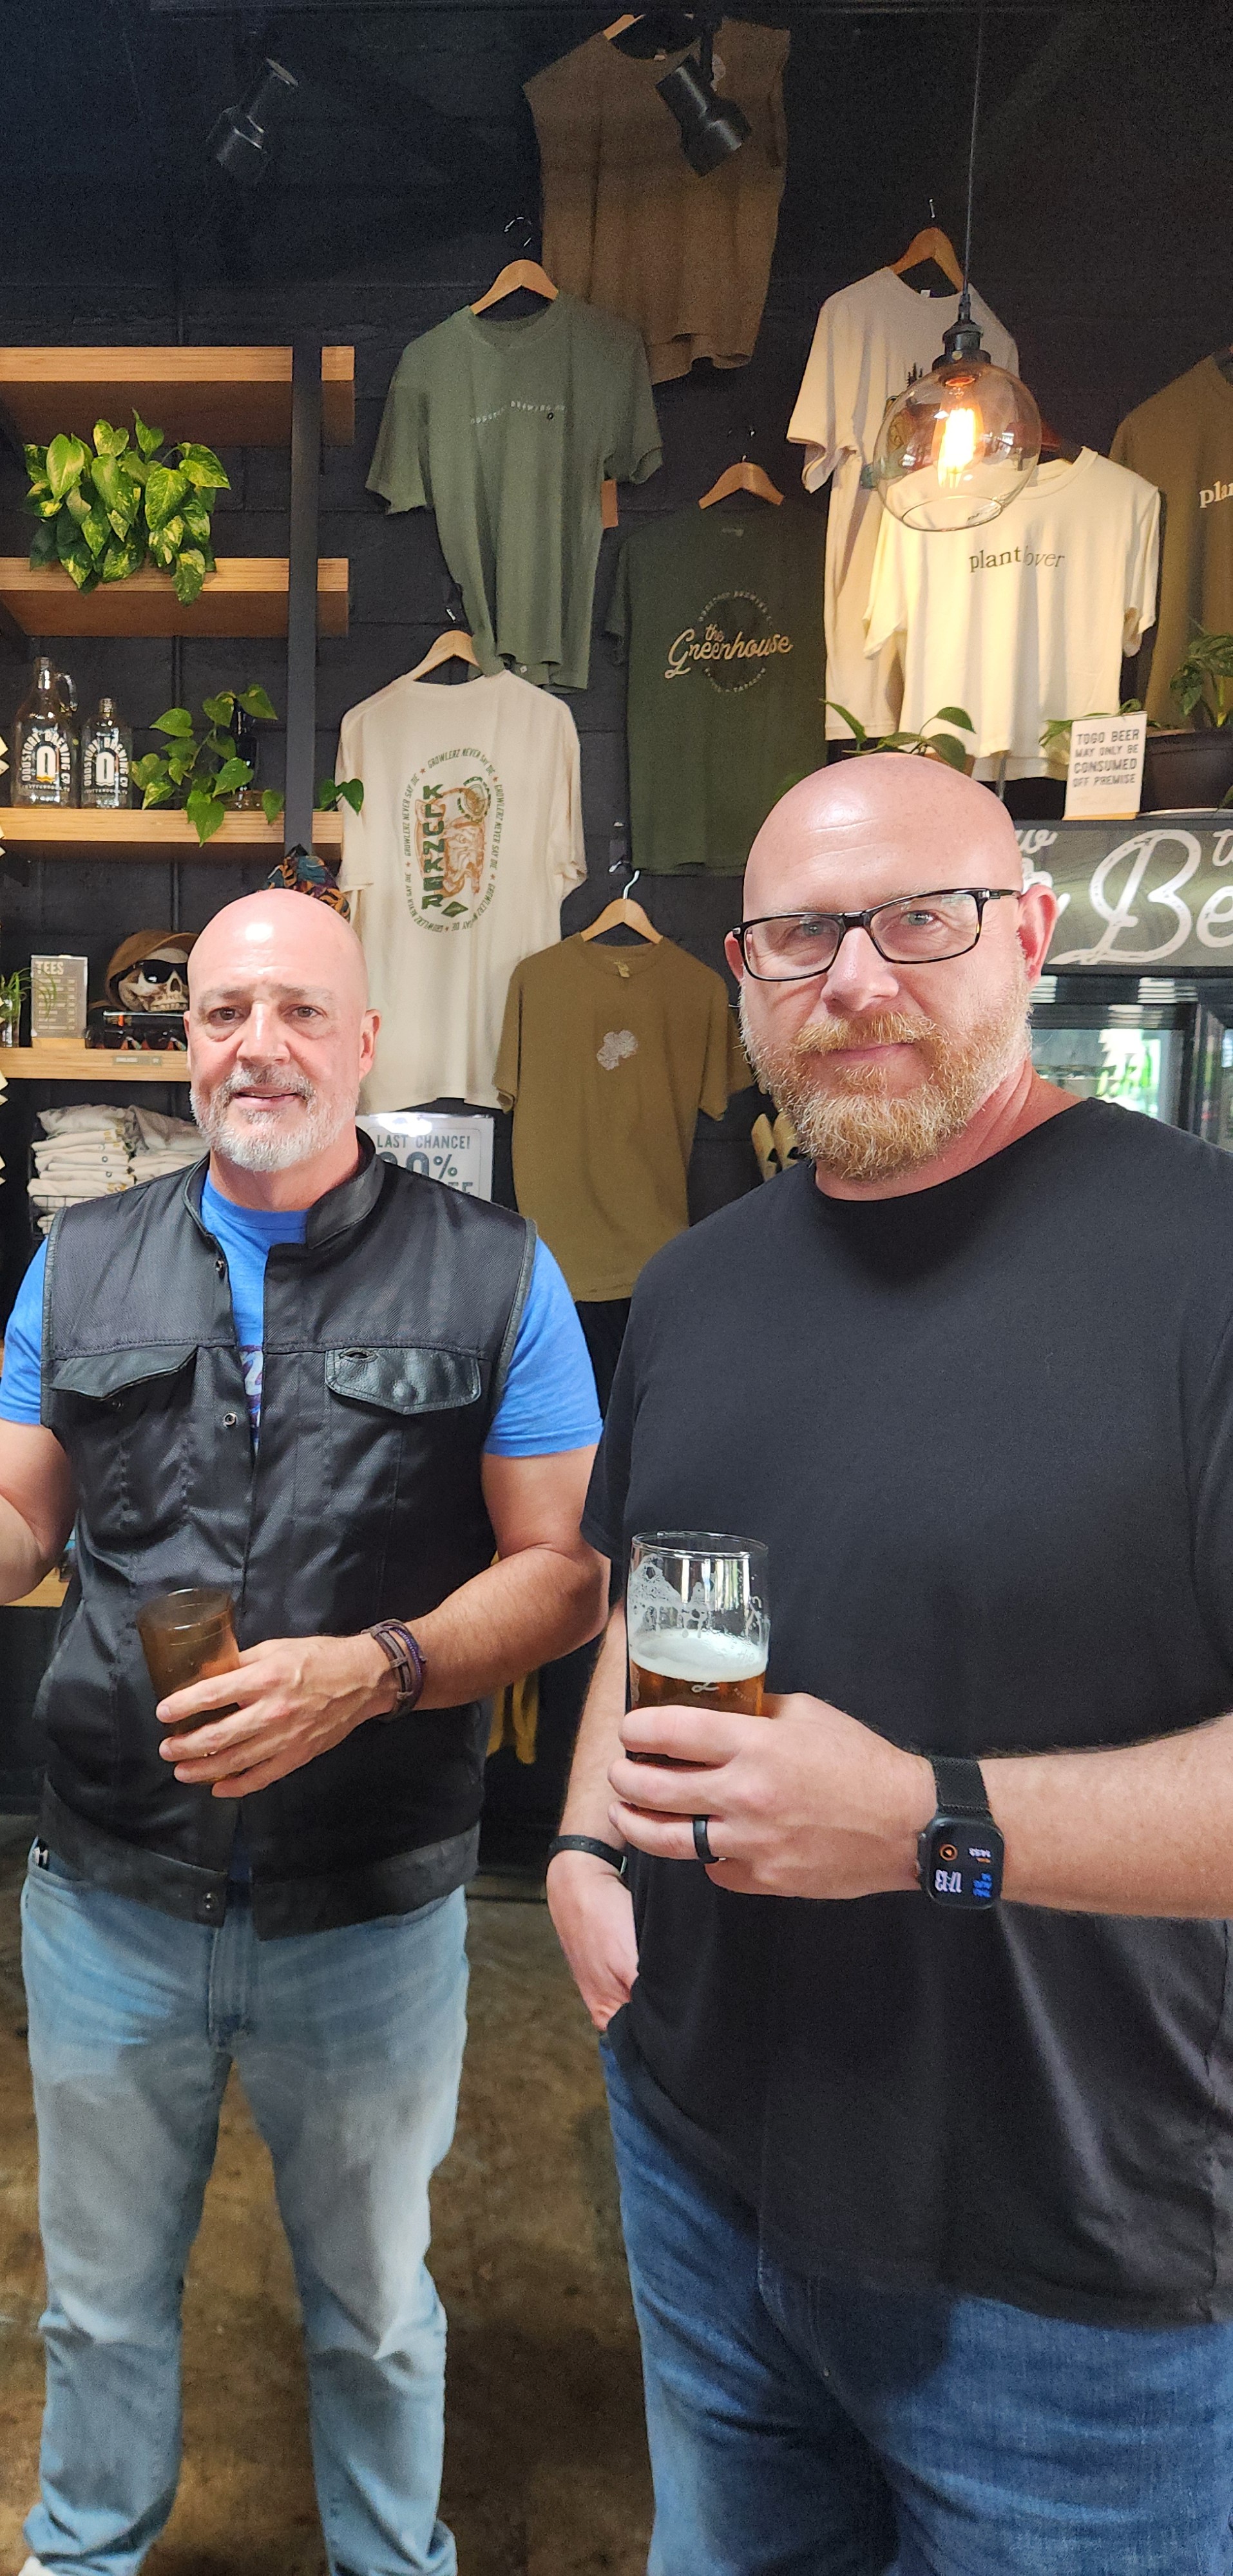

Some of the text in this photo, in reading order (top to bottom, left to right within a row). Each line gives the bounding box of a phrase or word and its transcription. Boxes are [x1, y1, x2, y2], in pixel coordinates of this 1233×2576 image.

[969, 546, 1022, 573] plant
[705, 623, 724, 641] the
[665, 629, 794, 679] Greenhouse
[1076, 729, 1140, 745] TOGO BEER
[428, 749, 460, 768] GROWLERZ
[462, 748, 481, 759] NEVER
[1075, 744, 1139, 758] MAY ONLY BE
[1074, 758, 1138, 774] CONSUMED
[1073, 773, 1136, 788] OFF PREMISE
[405, 784, 414, 799] SAY
[402, 799, 411, 821] NEVER
[493, 784, 505, 821] GROWLERZ
[403, 822, 412, 857] GROWLERZ
[492, 821, 503, 844] NEVER
[491, 844, 500, 858] SAY
[35, 961, 64, 975] TEES
[377, 1135, 408, 1148] LAST
